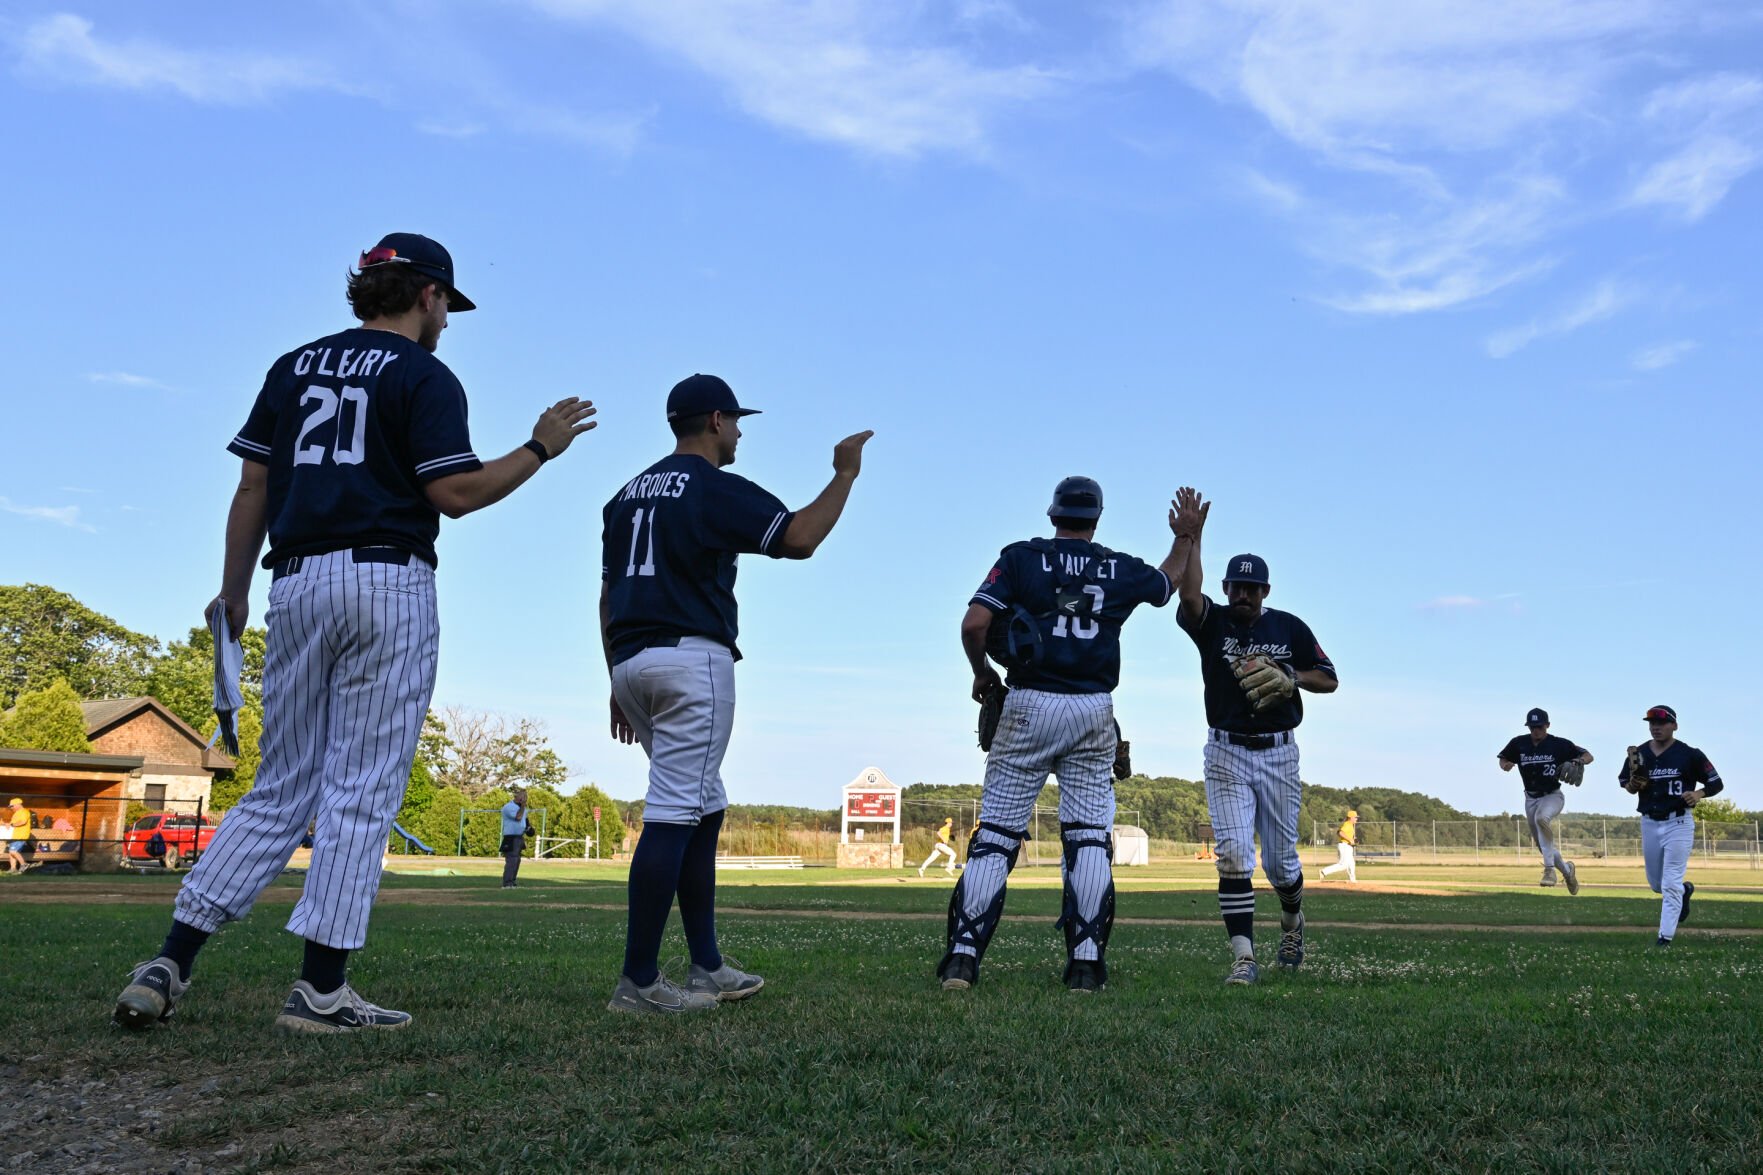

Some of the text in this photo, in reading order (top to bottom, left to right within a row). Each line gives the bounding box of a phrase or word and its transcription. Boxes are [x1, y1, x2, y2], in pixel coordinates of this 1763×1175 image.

[294, 385, 369, 467] 20
[626, 506, 655, 577] 11
[1543, 764, 1556, 776] 26
[1668, 780, 1683, 796] 13
